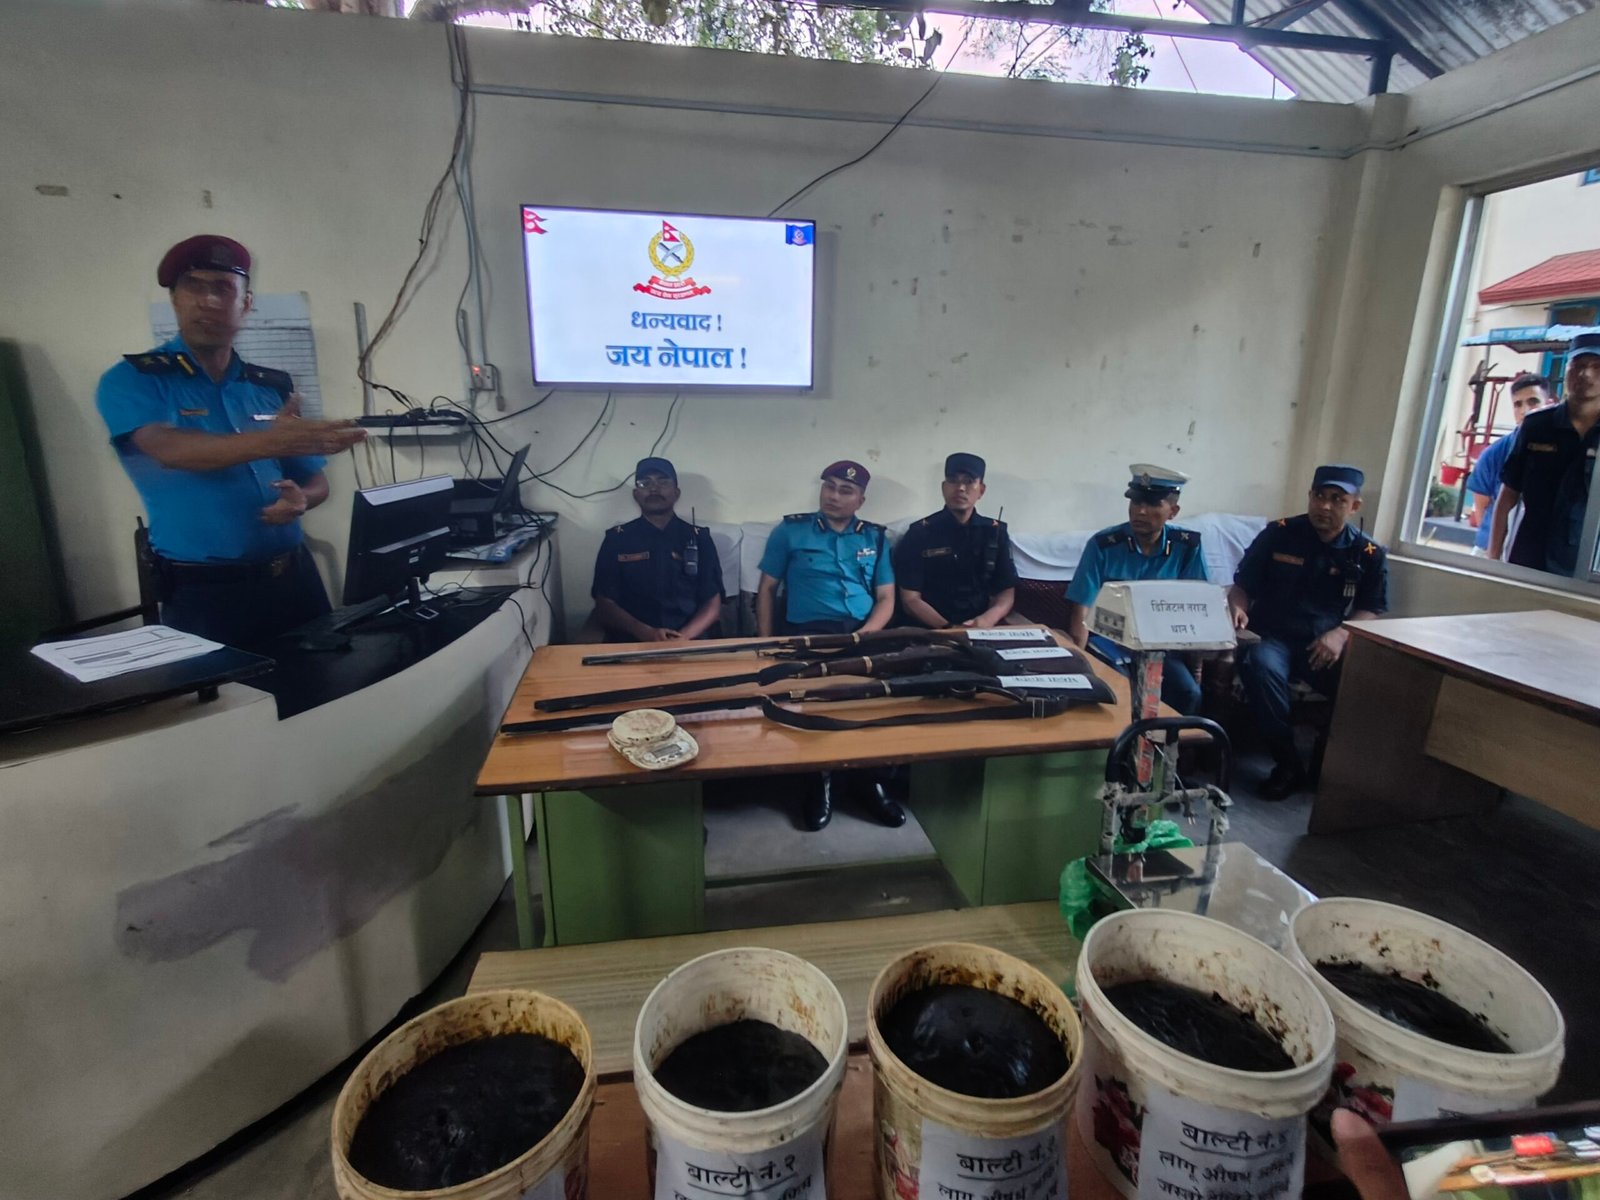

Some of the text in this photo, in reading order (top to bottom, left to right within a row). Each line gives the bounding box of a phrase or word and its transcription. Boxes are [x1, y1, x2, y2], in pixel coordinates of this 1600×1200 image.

[631, 311, 712, 332] धन्यवाद
[605, 345, 652, 367] जय
[657, 338, 734, 369] नेपाल
